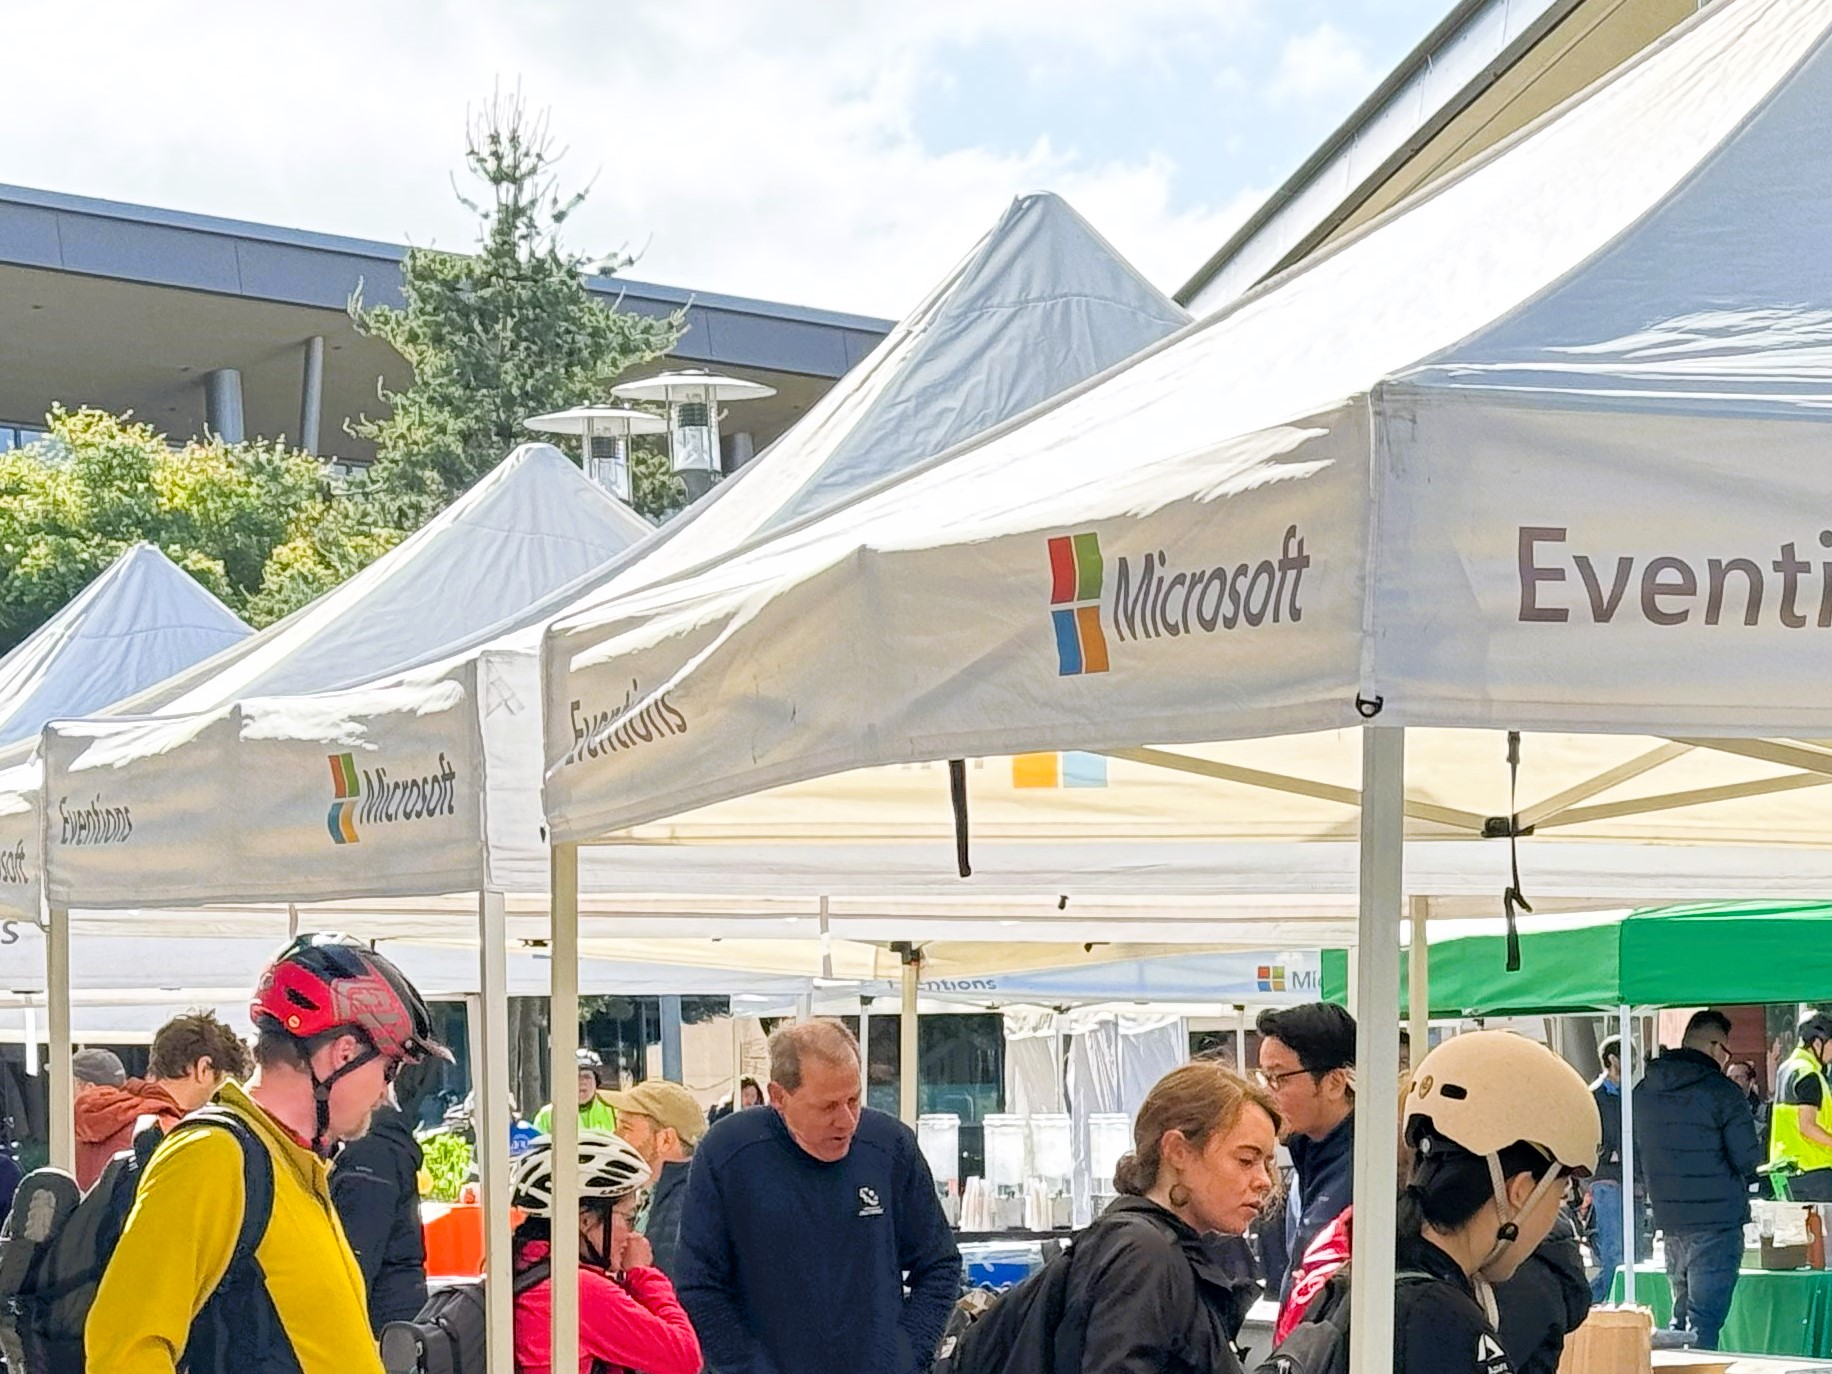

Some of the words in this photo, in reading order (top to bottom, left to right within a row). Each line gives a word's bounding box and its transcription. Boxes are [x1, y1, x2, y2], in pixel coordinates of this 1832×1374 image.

[1113, 525, 1310, 643] Microsoft
[59, 792, 133, 846] Eventions
[359, 751, 457, 825] Microsoft
[0, 838, 29, 884] soft
